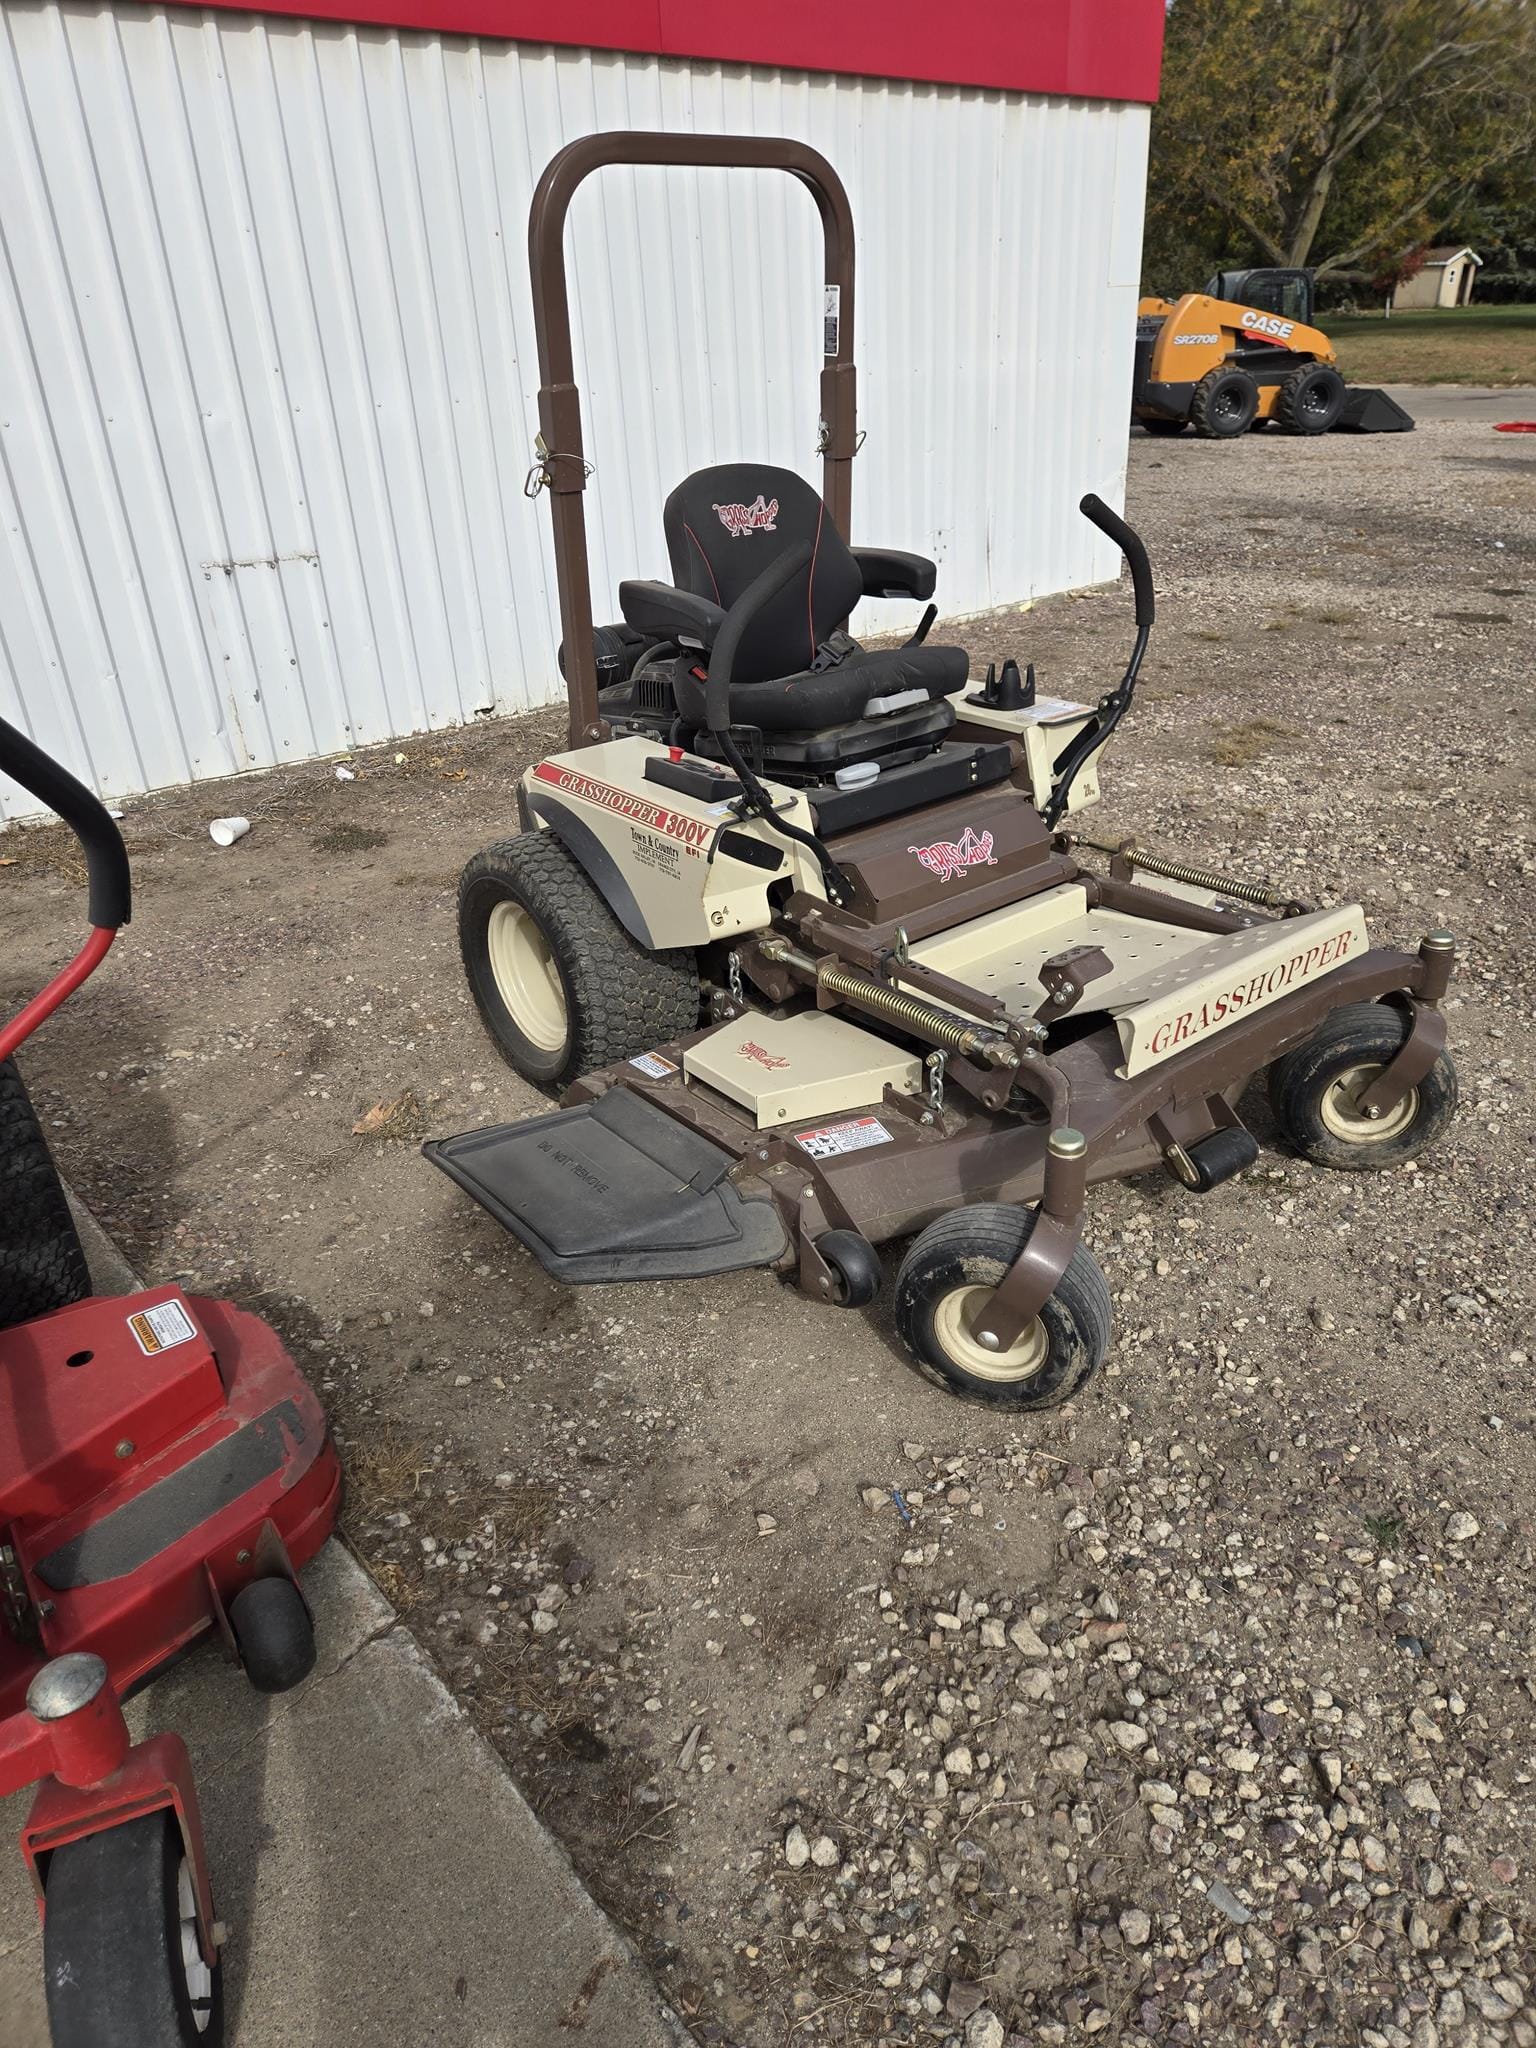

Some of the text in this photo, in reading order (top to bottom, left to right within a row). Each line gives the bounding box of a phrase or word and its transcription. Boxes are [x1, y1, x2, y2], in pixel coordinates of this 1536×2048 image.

[1241, 311, 1295, 339] CASE
[559, 772, 711, 846] GRASSHOPPER 300V
[630, 827, 680, 861] Town & Country
[637, 844, 674, 867] IMPLEMENT
[685, 846, 701, 859] EFI
[1151, 930, 1353, 1055] GRASSHOPPER
[826, 1122, 860, 1134] DANGER
[536, 1141, 610, 1194] DO NOT REMOVE
[135, 1317, 155, 1347] WARNING
